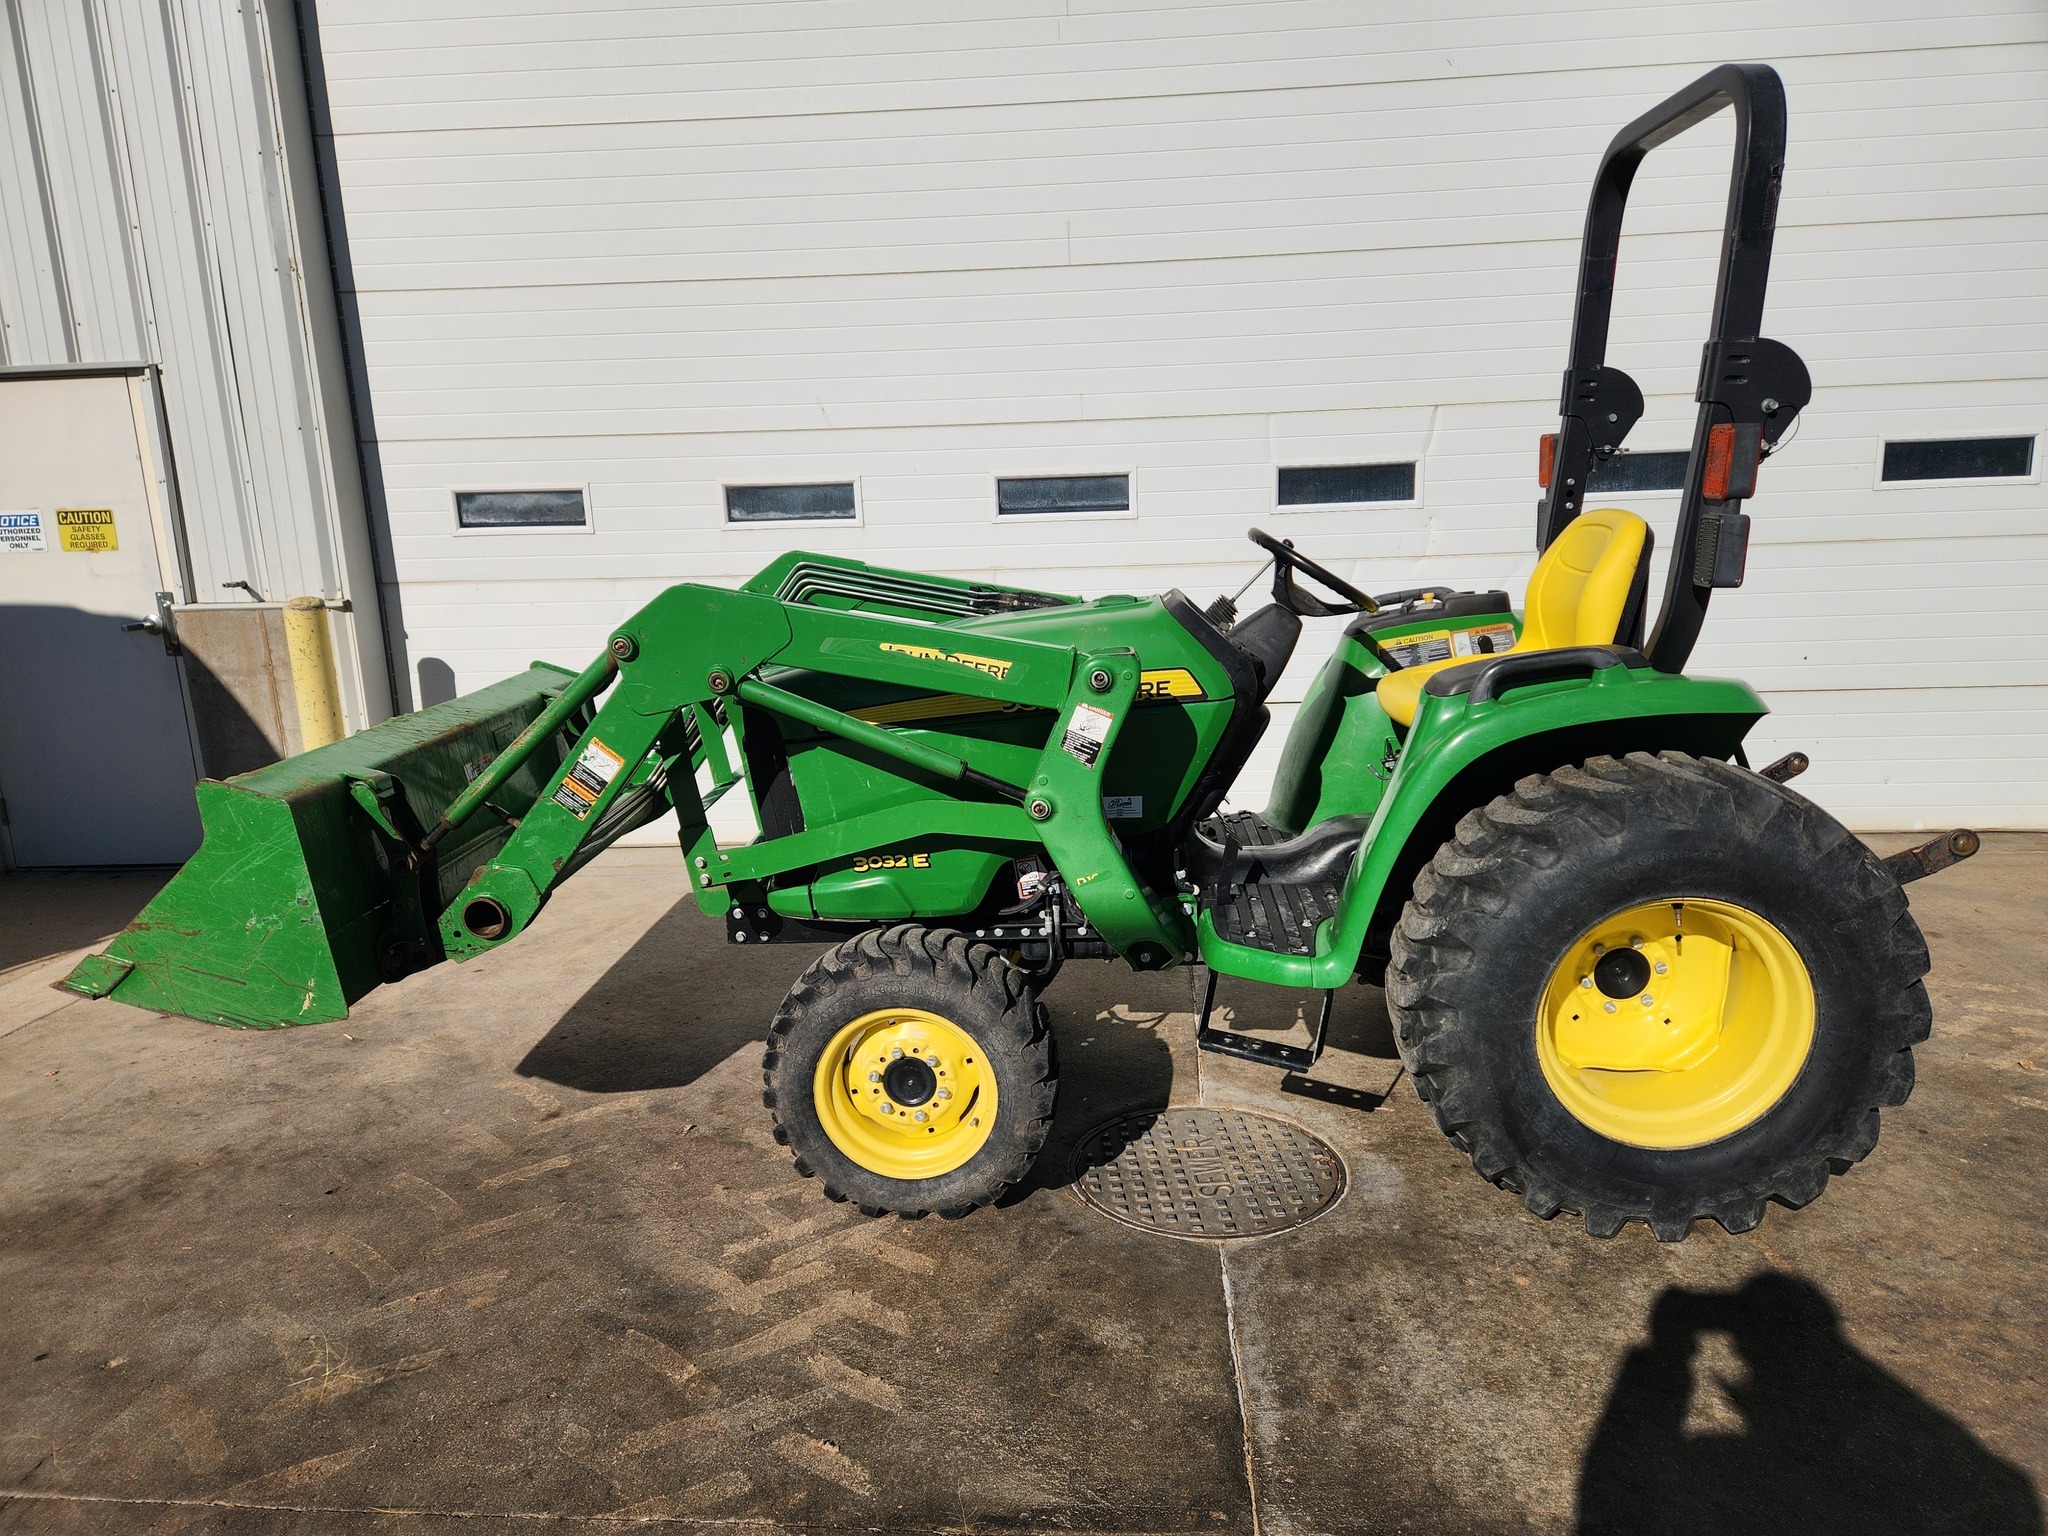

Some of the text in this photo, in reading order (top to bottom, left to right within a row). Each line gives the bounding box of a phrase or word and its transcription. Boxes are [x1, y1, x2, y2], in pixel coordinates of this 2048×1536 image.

[0, 515, 37, 526] OTICE
[58, 511, 111, 524] CAUTION
[70, 533, 105, 541] GLASSES
[70, 541, 108, 549] REQUIRED
[1403, 634, 1434, 644] CAUTION
[1138, 680, 1171, 698] RE
[852, 853, 930, 873] 3032 E
[1183, 1138, 1235, 1198] SEWER
